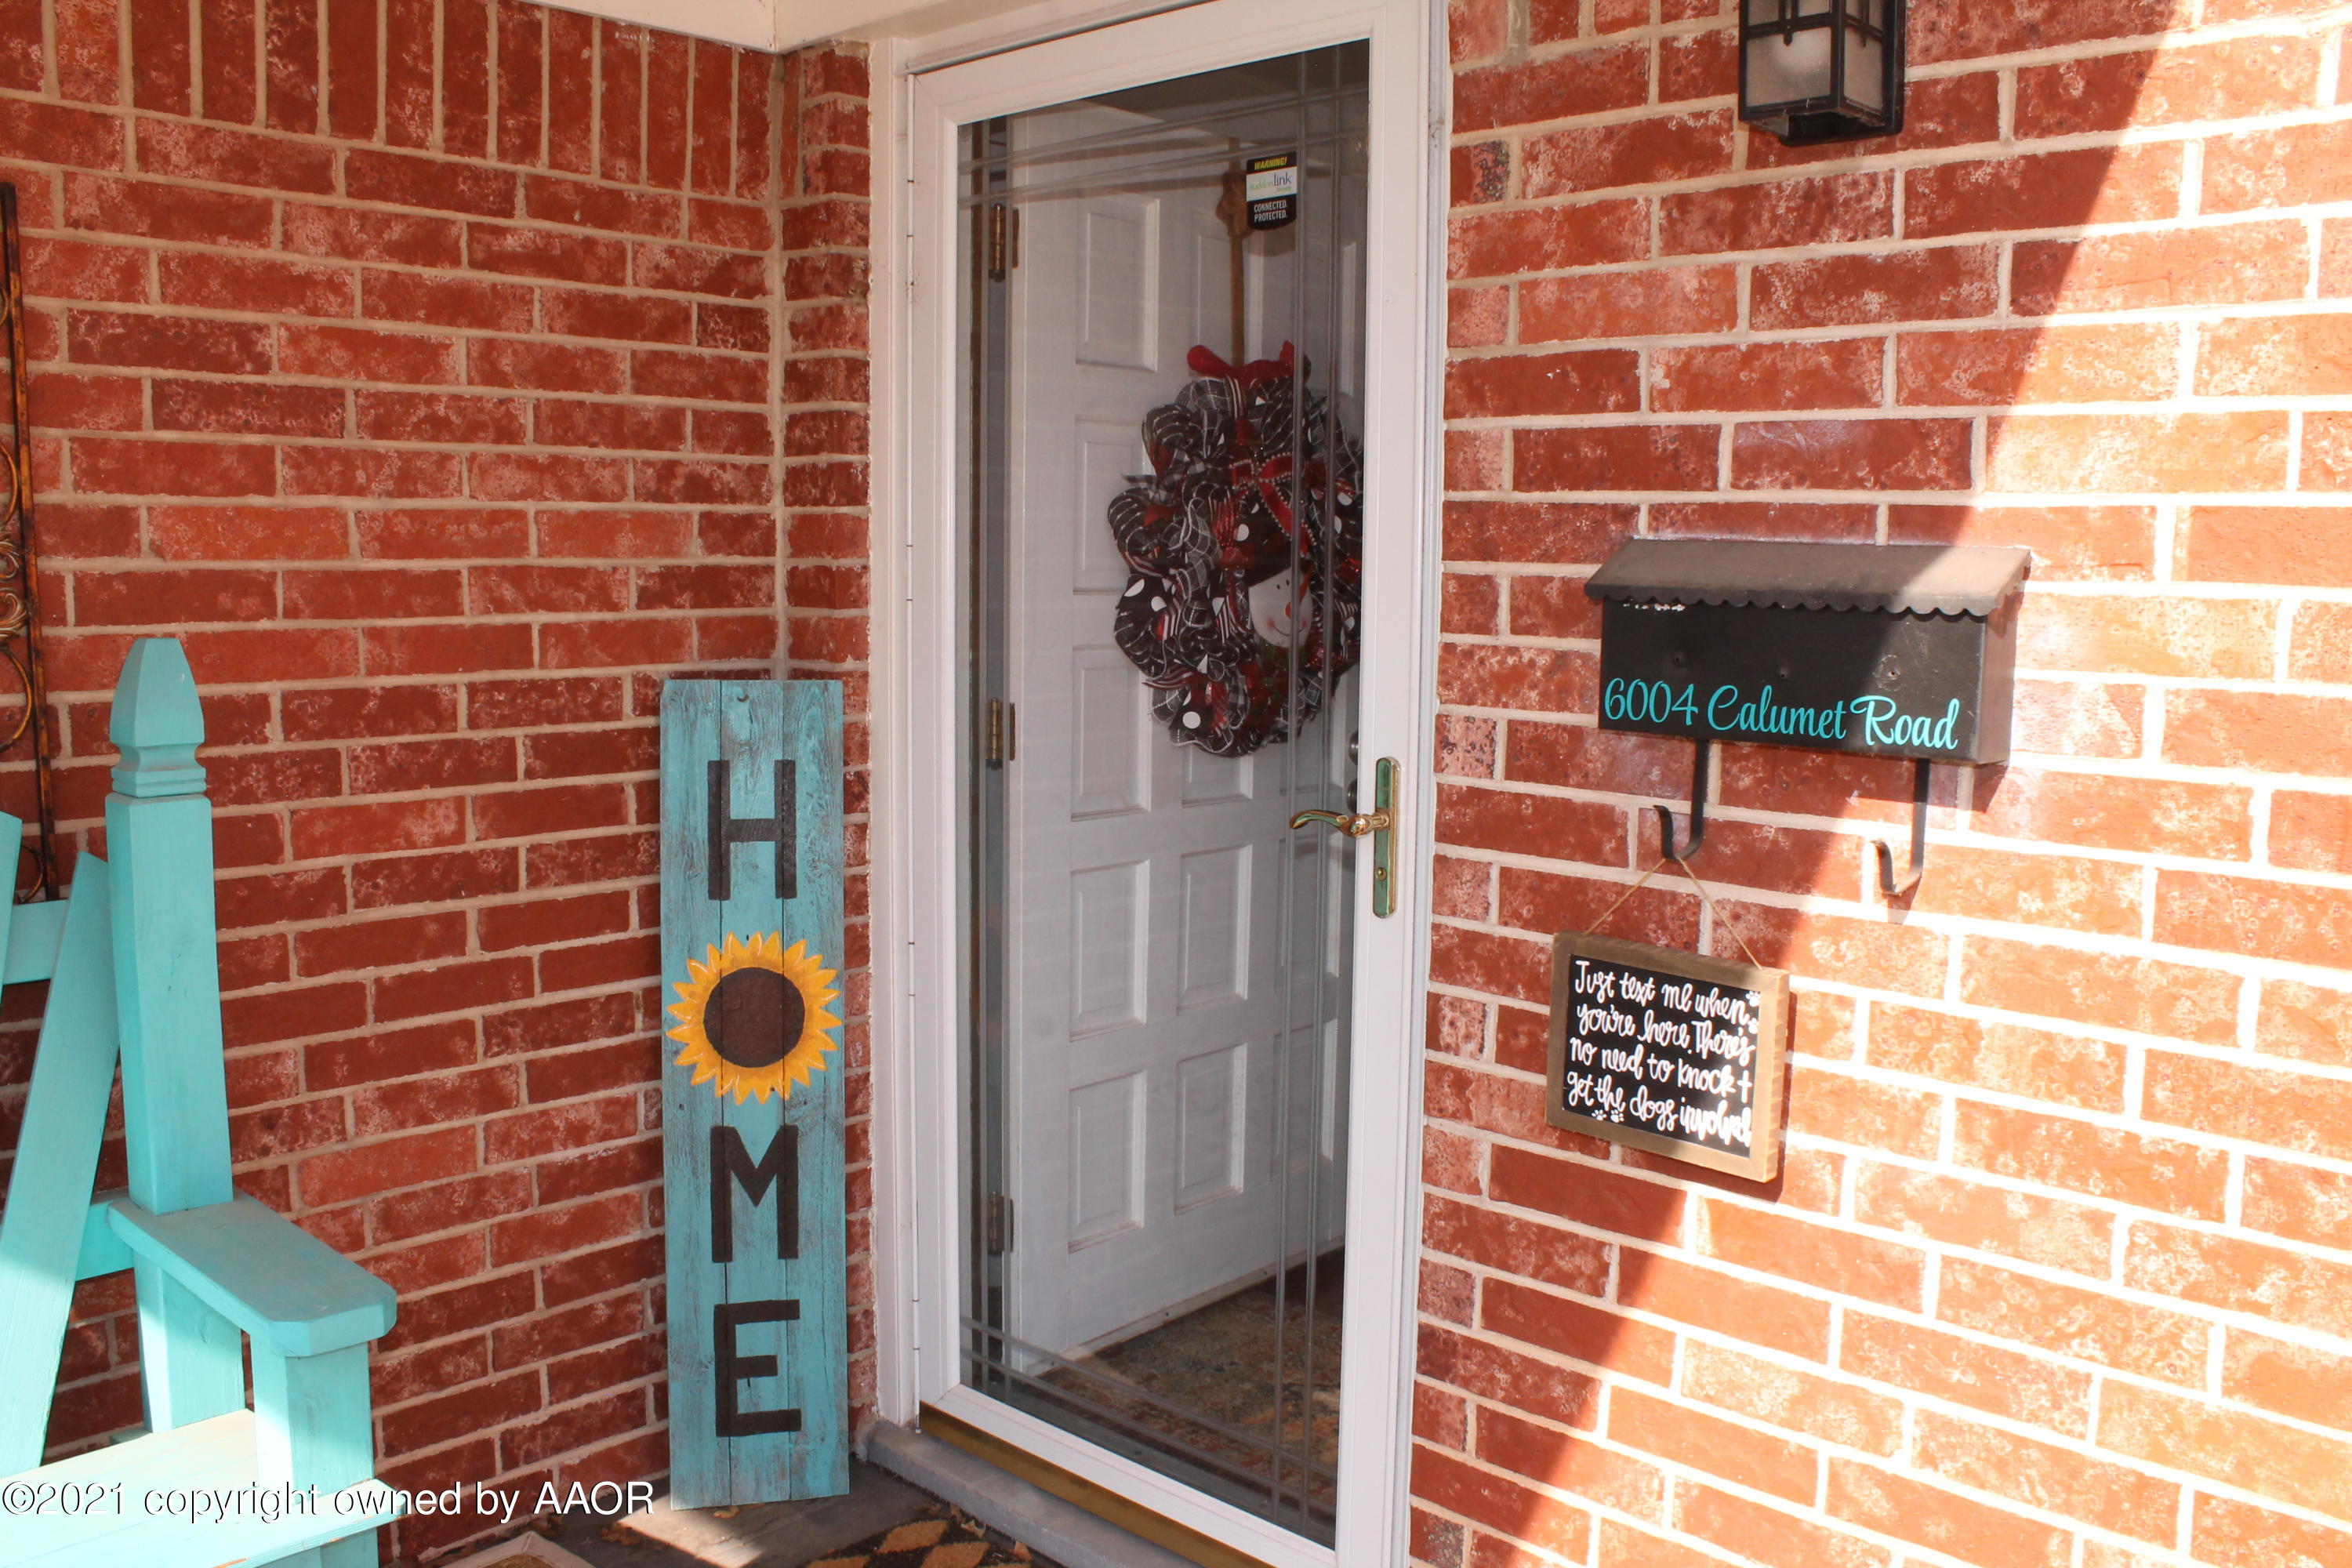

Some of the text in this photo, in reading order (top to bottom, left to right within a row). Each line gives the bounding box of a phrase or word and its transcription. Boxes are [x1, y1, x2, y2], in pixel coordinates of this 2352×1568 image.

[1254, 157, 1287, 170] WARNING!
[1604, 677, 1959, 750] 6004 Calumet Road
[1574, 960, 1750, 1025] Just text me when
[1570, 1036, 1598, 1066] no
[1601, 1044, 1643, 1080] need
[1646, 1052, 1675, 1083] to
[1678, 1058, 1737, 1098] knock
[1577, 1003, 1636, 1036] you're
[1691, 1019, 1756, 1067] There's
[1567, 1071, 1753, 1148] get the dogs involved
